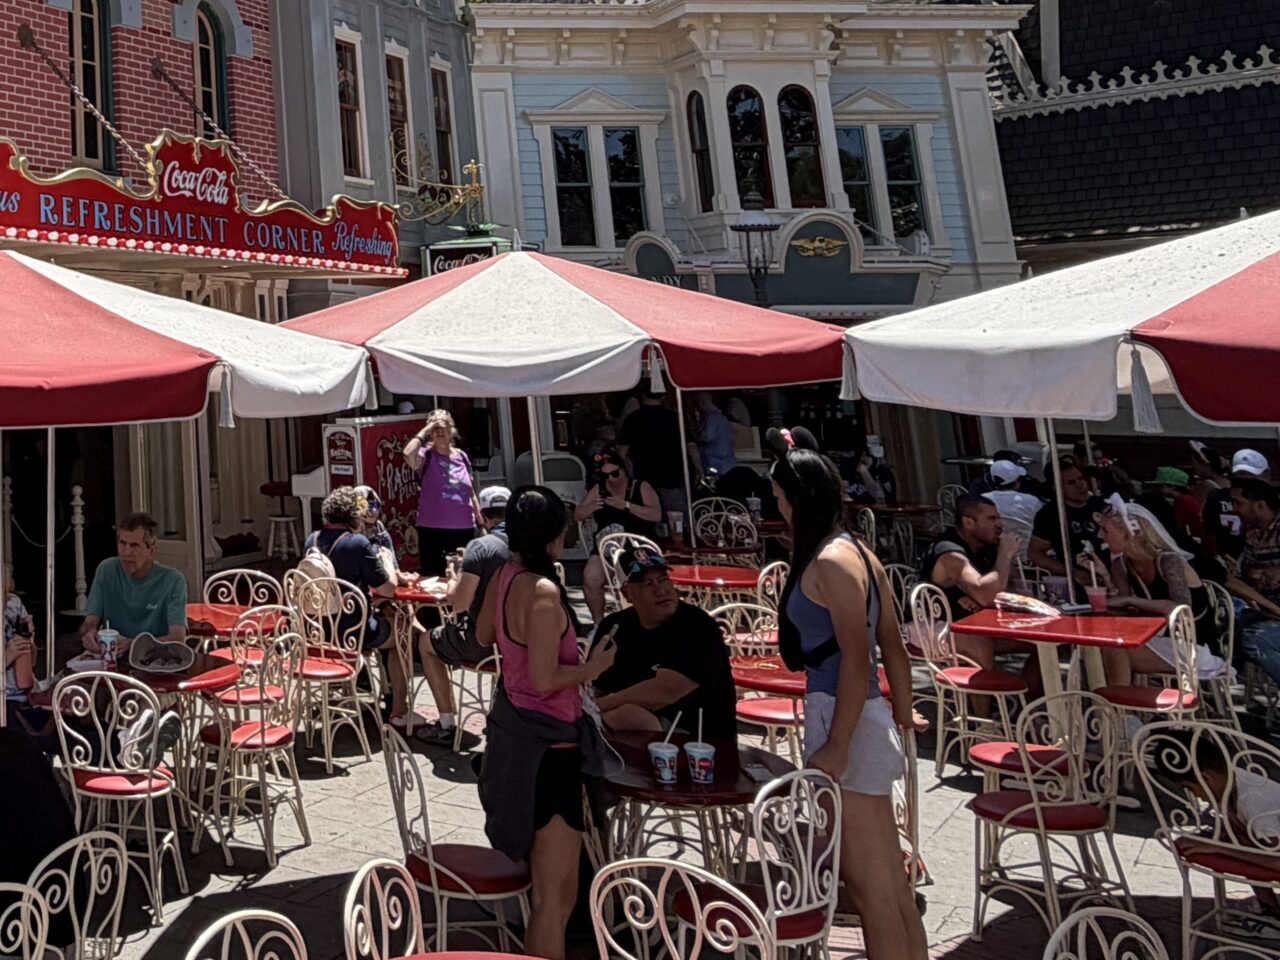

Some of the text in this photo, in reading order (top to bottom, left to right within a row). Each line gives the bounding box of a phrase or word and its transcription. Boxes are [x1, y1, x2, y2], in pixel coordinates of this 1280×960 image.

[163, 160, 230, 205] Coca-Cola
[38, 192, 229, 244] REFRESHMENT
[242, 220, 325, 255] CORNER
[331, 220, 395, 264] Refreshing
